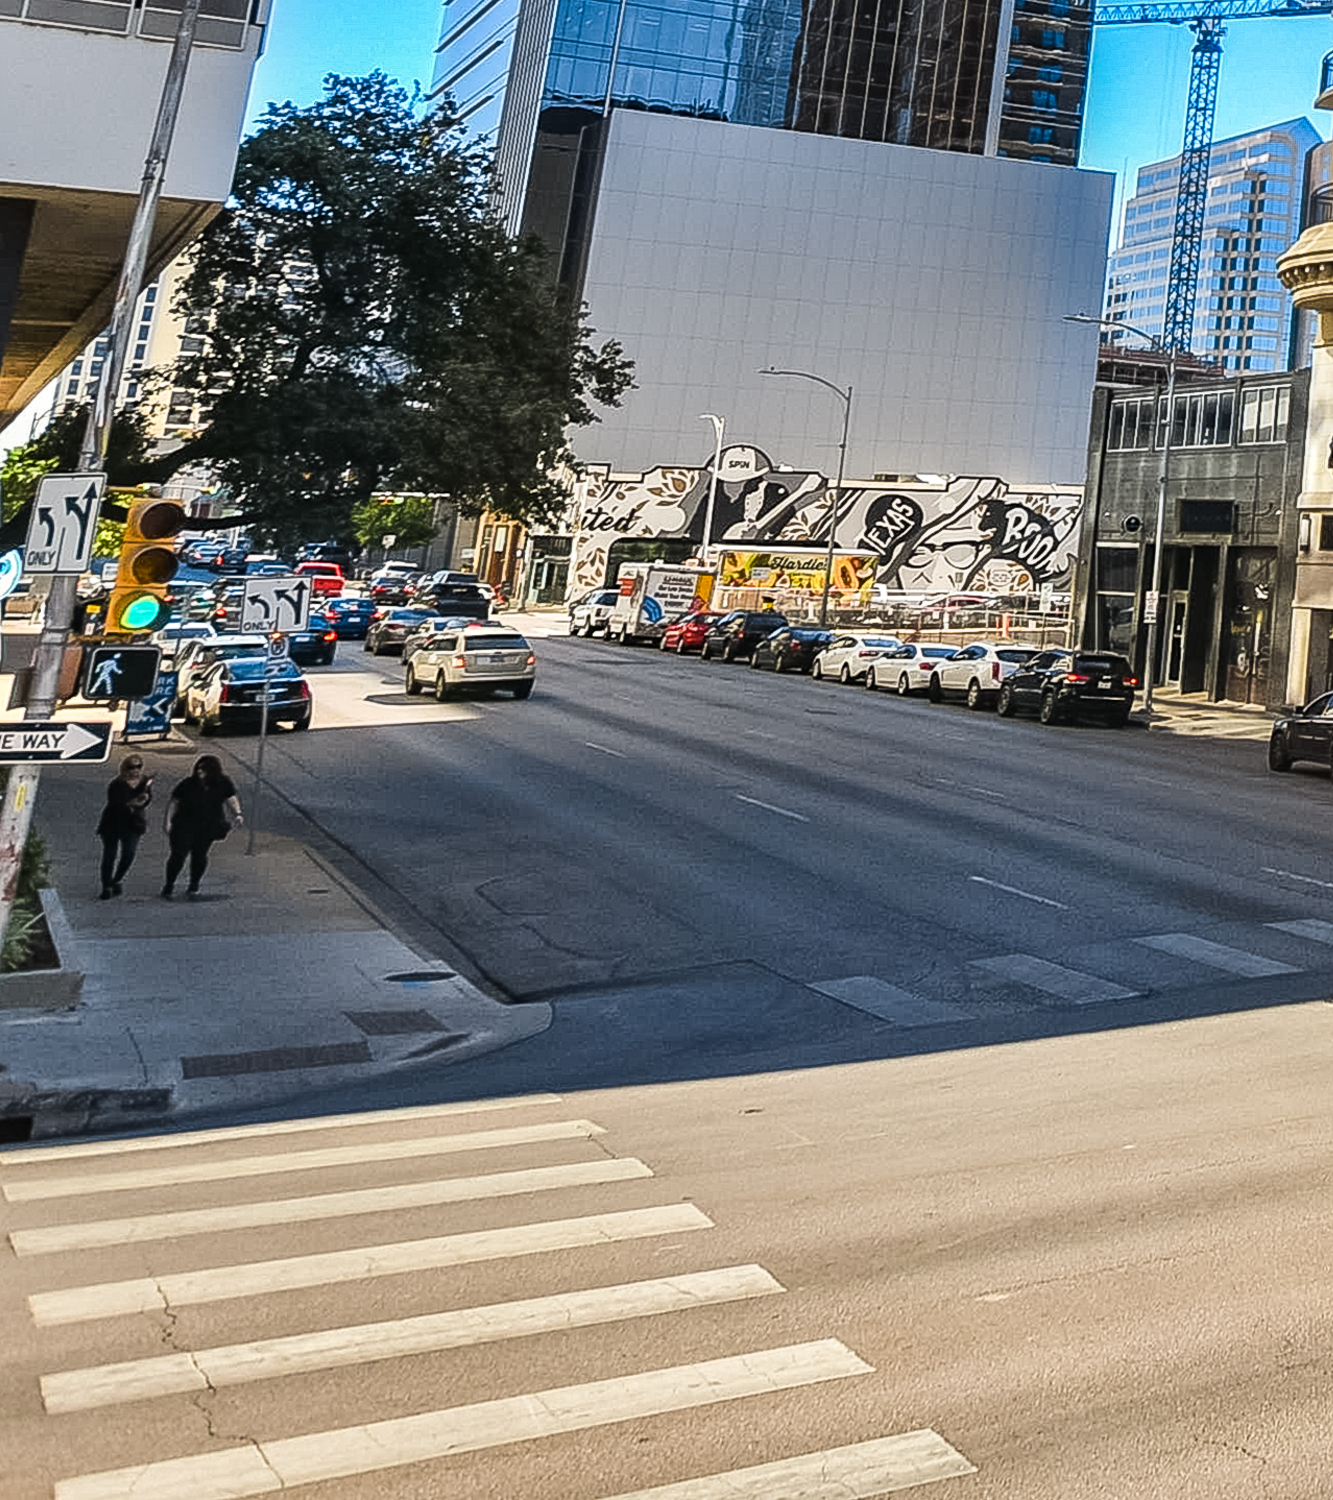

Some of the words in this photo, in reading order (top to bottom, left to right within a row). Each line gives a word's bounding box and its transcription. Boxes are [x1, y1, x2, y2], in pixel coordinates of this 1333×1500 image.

[728, 460, 750, 469] SPIN
[27, 550, 55, 567] ONLY
[243, 621, 274, 632] ONLY
[22, 733, 65, 749] WAY
